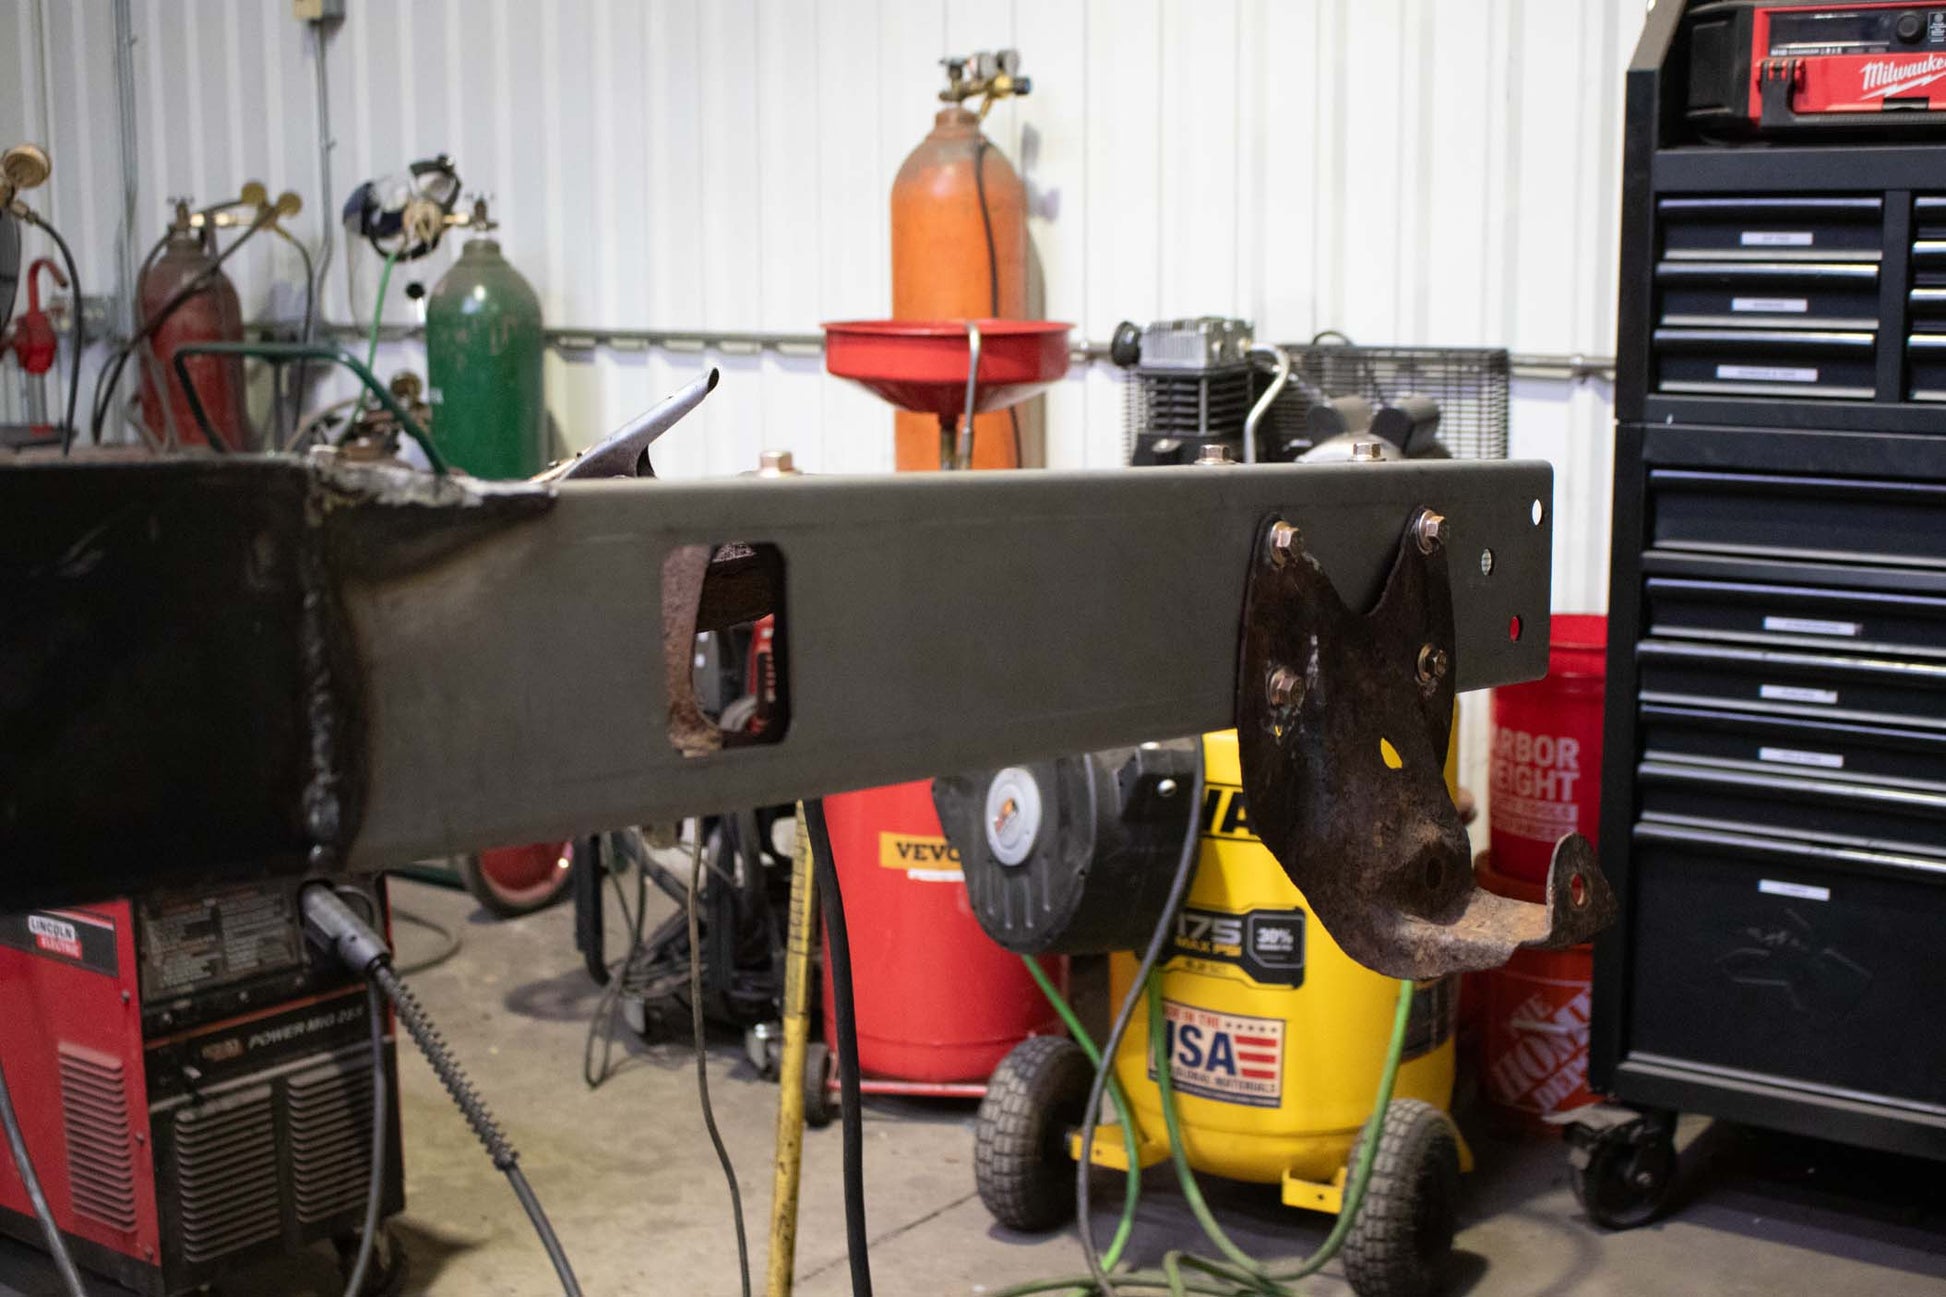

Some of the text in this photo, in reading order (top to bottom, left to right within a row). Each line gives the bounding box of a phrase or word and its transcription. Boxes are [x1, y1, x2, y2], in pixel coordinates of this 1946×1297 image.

[896, 841, 961, 863] VEVO
[31, 918, 73, 939] LINCOLN
[1177, 912, 1241, 945] 175
